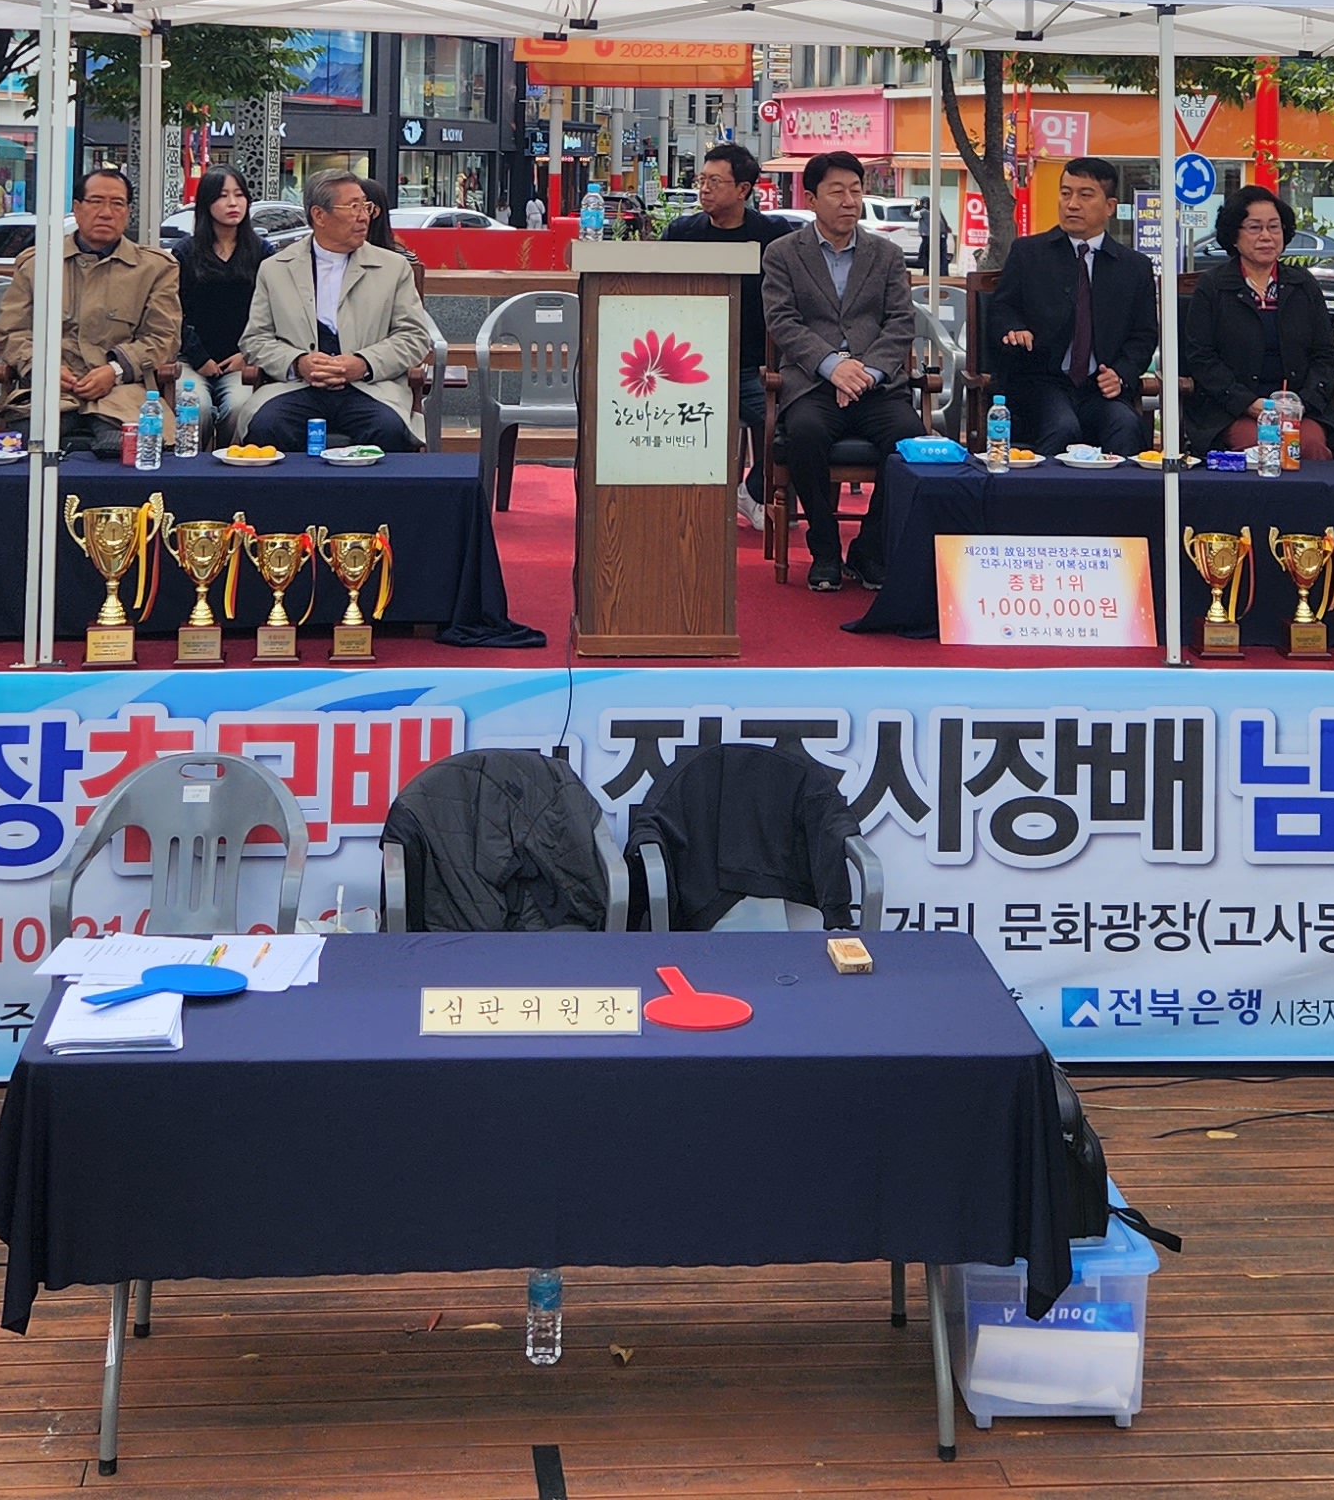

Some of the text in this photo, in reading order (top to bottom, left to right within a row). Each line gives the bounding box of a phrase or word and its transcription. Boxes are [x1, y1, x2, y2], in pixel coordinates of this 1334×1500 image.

[619, 42, 738, 59] 2023.4.27-5.6
[763, 105, 779, 120] 약
[1180, 109, 1206, 118] YIELD
[1041, 115, 1078, 154] 약
[677, 401, 715, 449] 전주
[629, 435, 697, 448] 세계를 비빈다
[964, 546, 999, 557] 제20회
[1008, 574, 1085, 592] 종합 1위
[978, 597, 1118, 619] 1,000,000원
[1019, 626, 1099, 638] 전주시복싱협회
[441, 995, 621, 1026] 심판위원장
[1107, 986, 1263, 1028] 전북은행
